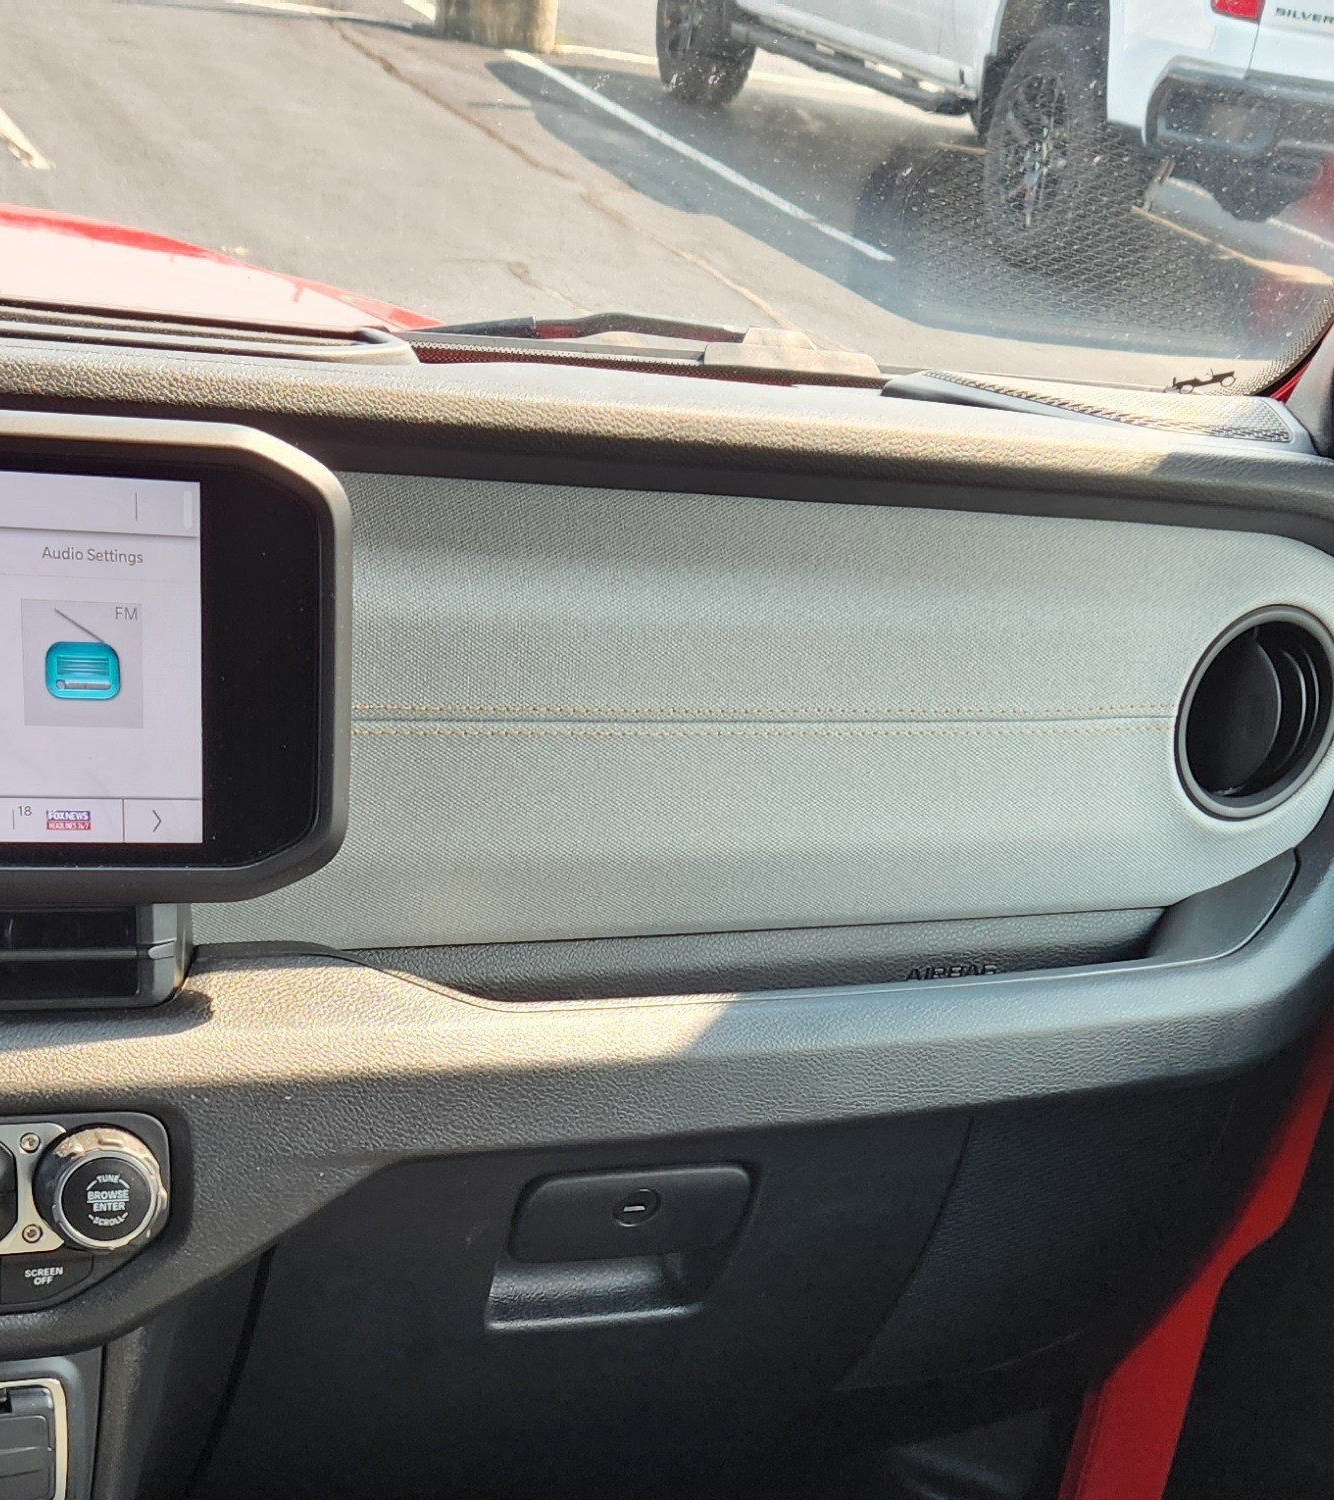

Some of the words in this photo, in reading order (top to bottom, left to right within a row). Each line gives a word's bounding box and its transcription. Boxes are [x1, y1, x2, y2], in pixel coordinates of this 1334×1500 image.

[42, 546, 83, 562] Audio
[87, 548, 144, 566] Settings
[115, 606, 138, 621] FM
[18, 806, 33, 817] 18
[96, 1174, 121, 1184] TUNE
[87, 1189, 129, 1200] BROWSE
[92, 1202, 126, 1212] ENTER
[92, 1216, 124, 1226] SCROLL
[24, 1266, 64, 1278] SCREEN
[33, 1276, 54, 1286] OFF
